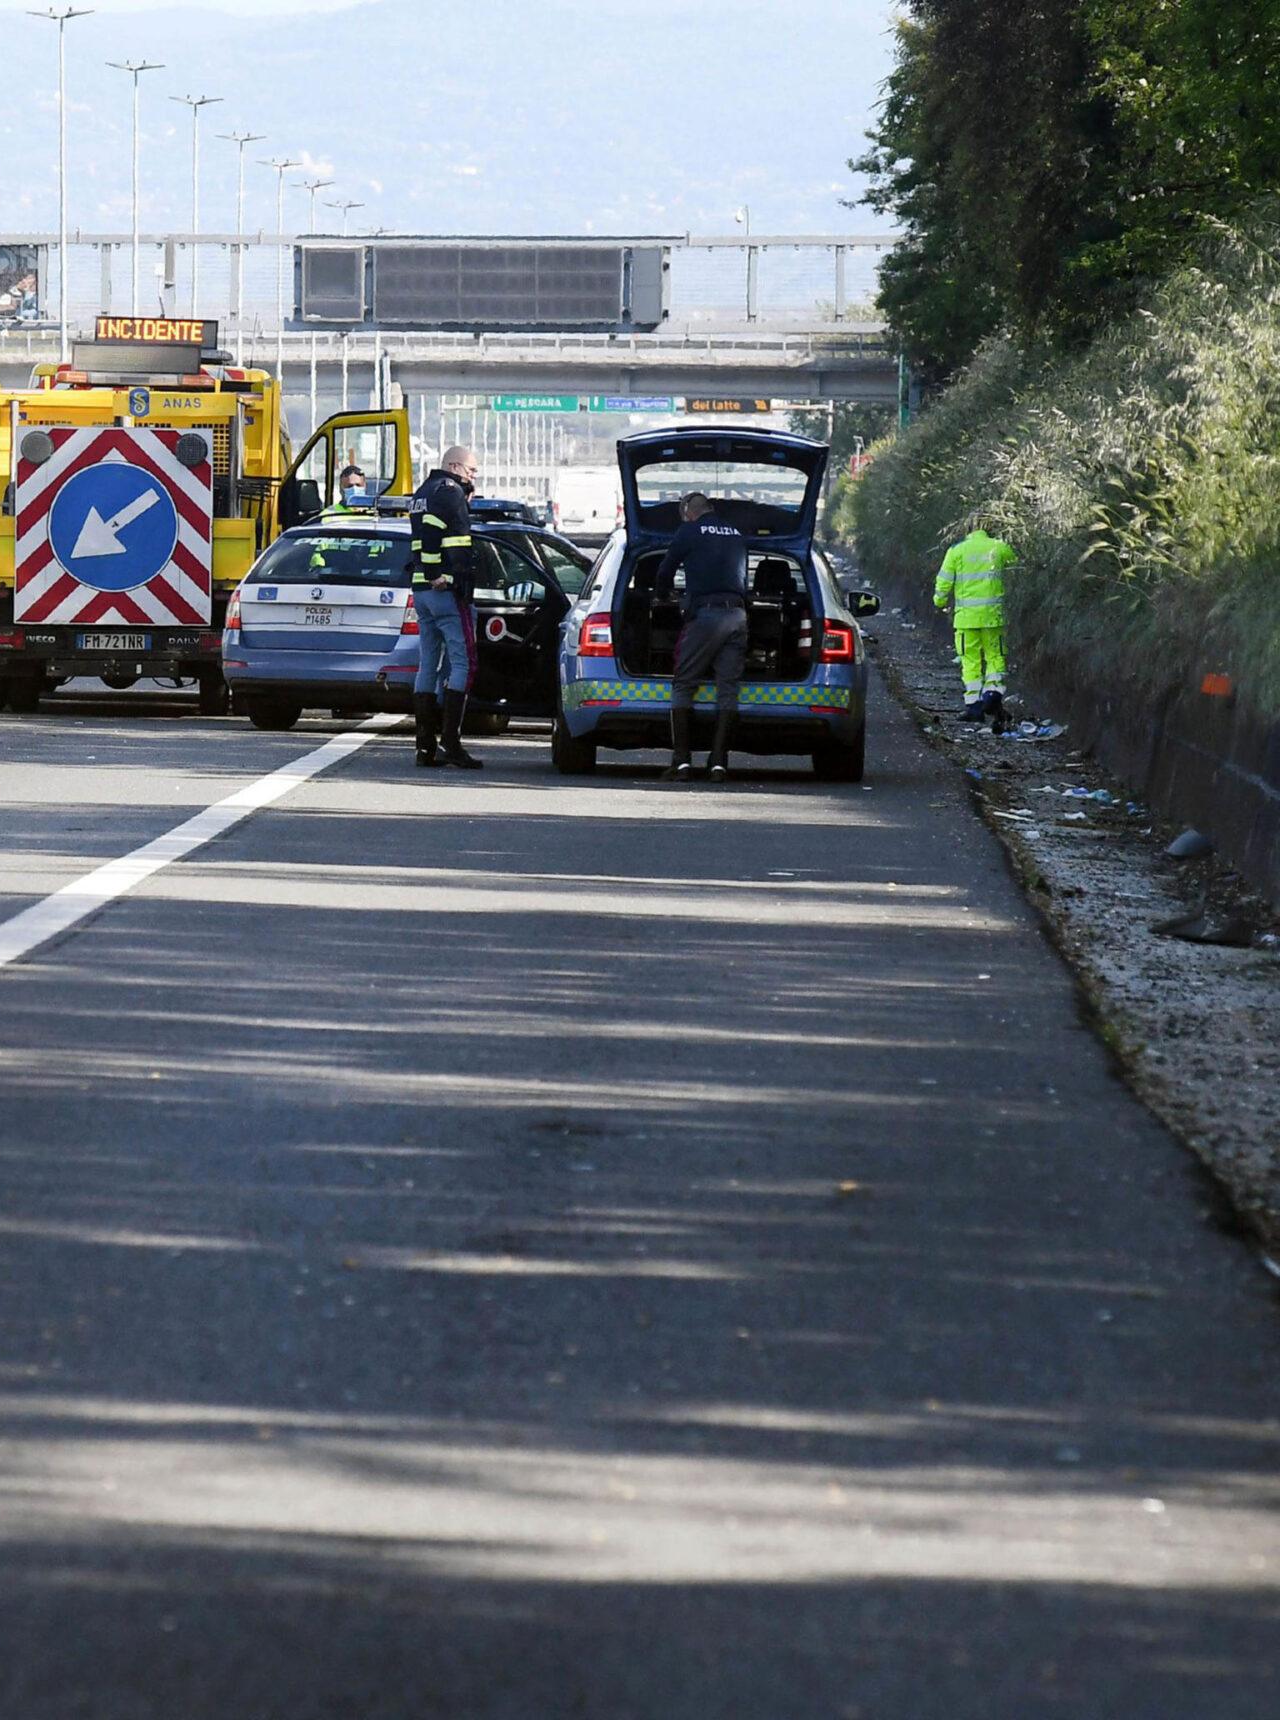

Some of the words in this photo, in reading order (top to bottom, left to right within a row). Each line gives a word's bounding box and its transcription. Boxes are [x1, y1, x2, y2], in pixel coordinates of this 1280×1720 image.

[97, 318, 204, 342] INCIDENTE
[163, 397, 201, 409] ANAS
[515, 397, 562, 408] PESCARA
[700, 525, 742, 537] POLIZIA
[305, 606, 332, 615] POLIZIA
[26, 635, 56, 643] IVECO
[168, 637, 200, 645] DAILY
